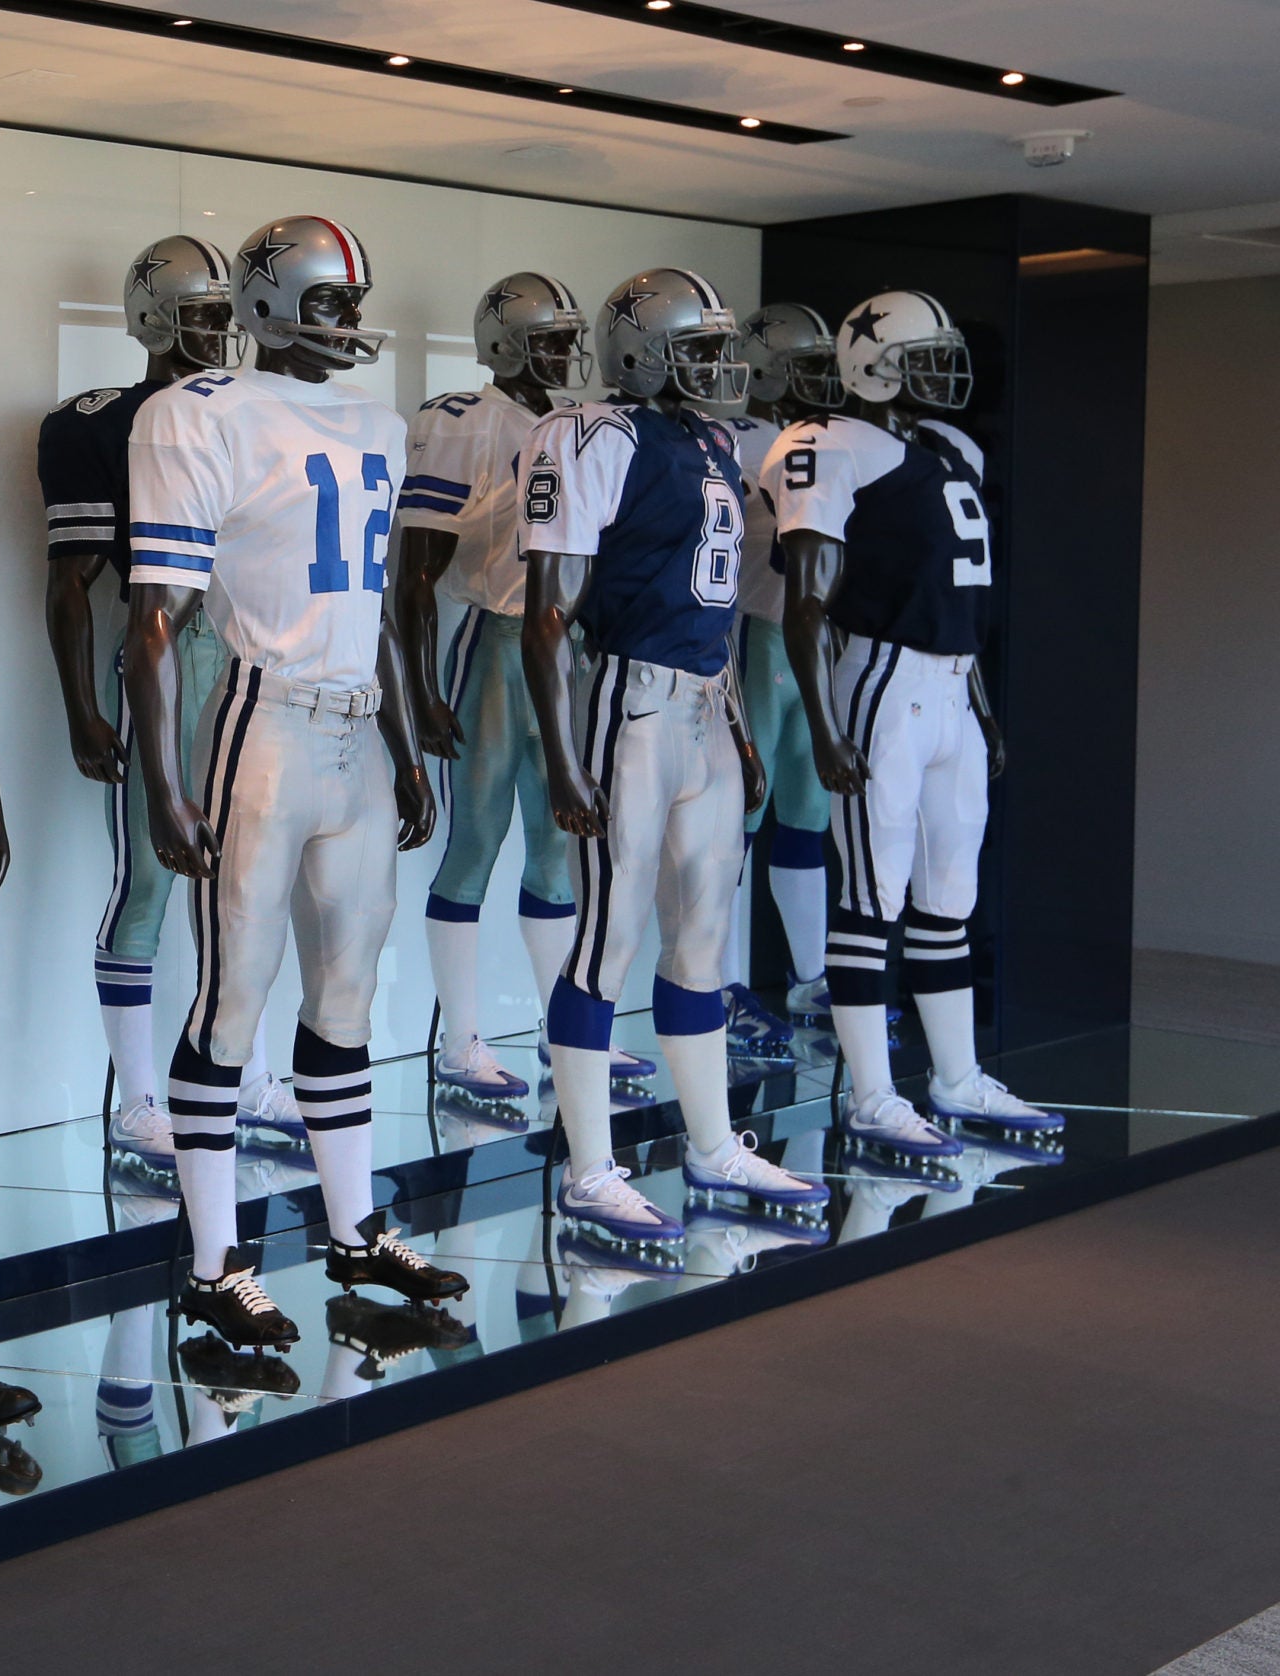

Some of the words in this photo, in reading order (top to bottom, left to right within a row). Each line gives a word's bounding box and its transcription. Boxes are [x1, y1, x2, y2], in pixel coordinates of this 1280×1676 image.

[524, 469, 561, 525] 8
[785, 448, 816, 491] 9
[305, 452, 393, 594] 12
[691, 477, 745, 609] 8
[942, 481, 992, 587] 9
